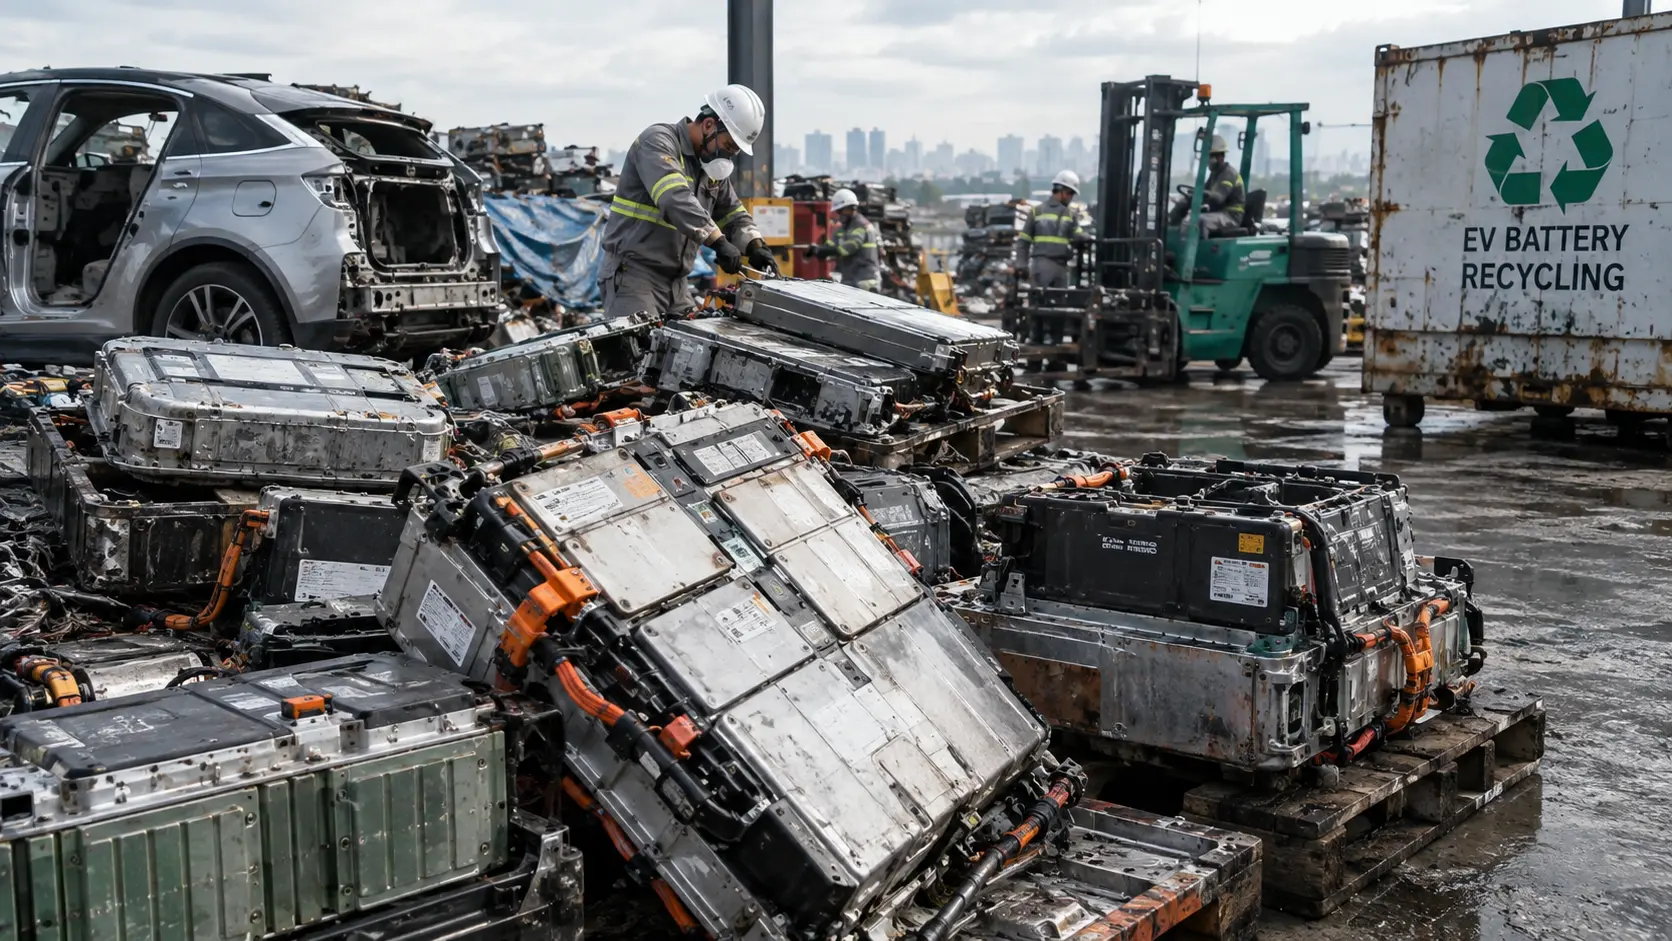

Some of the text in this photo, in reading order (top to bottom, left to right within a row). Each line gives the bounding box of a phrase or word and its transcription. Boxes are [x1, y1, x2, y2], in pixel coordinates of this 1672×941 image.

[1463, 224, 1630, 252] EV BATTERY
[1461, 262, 1625, 292] RECYCLING
